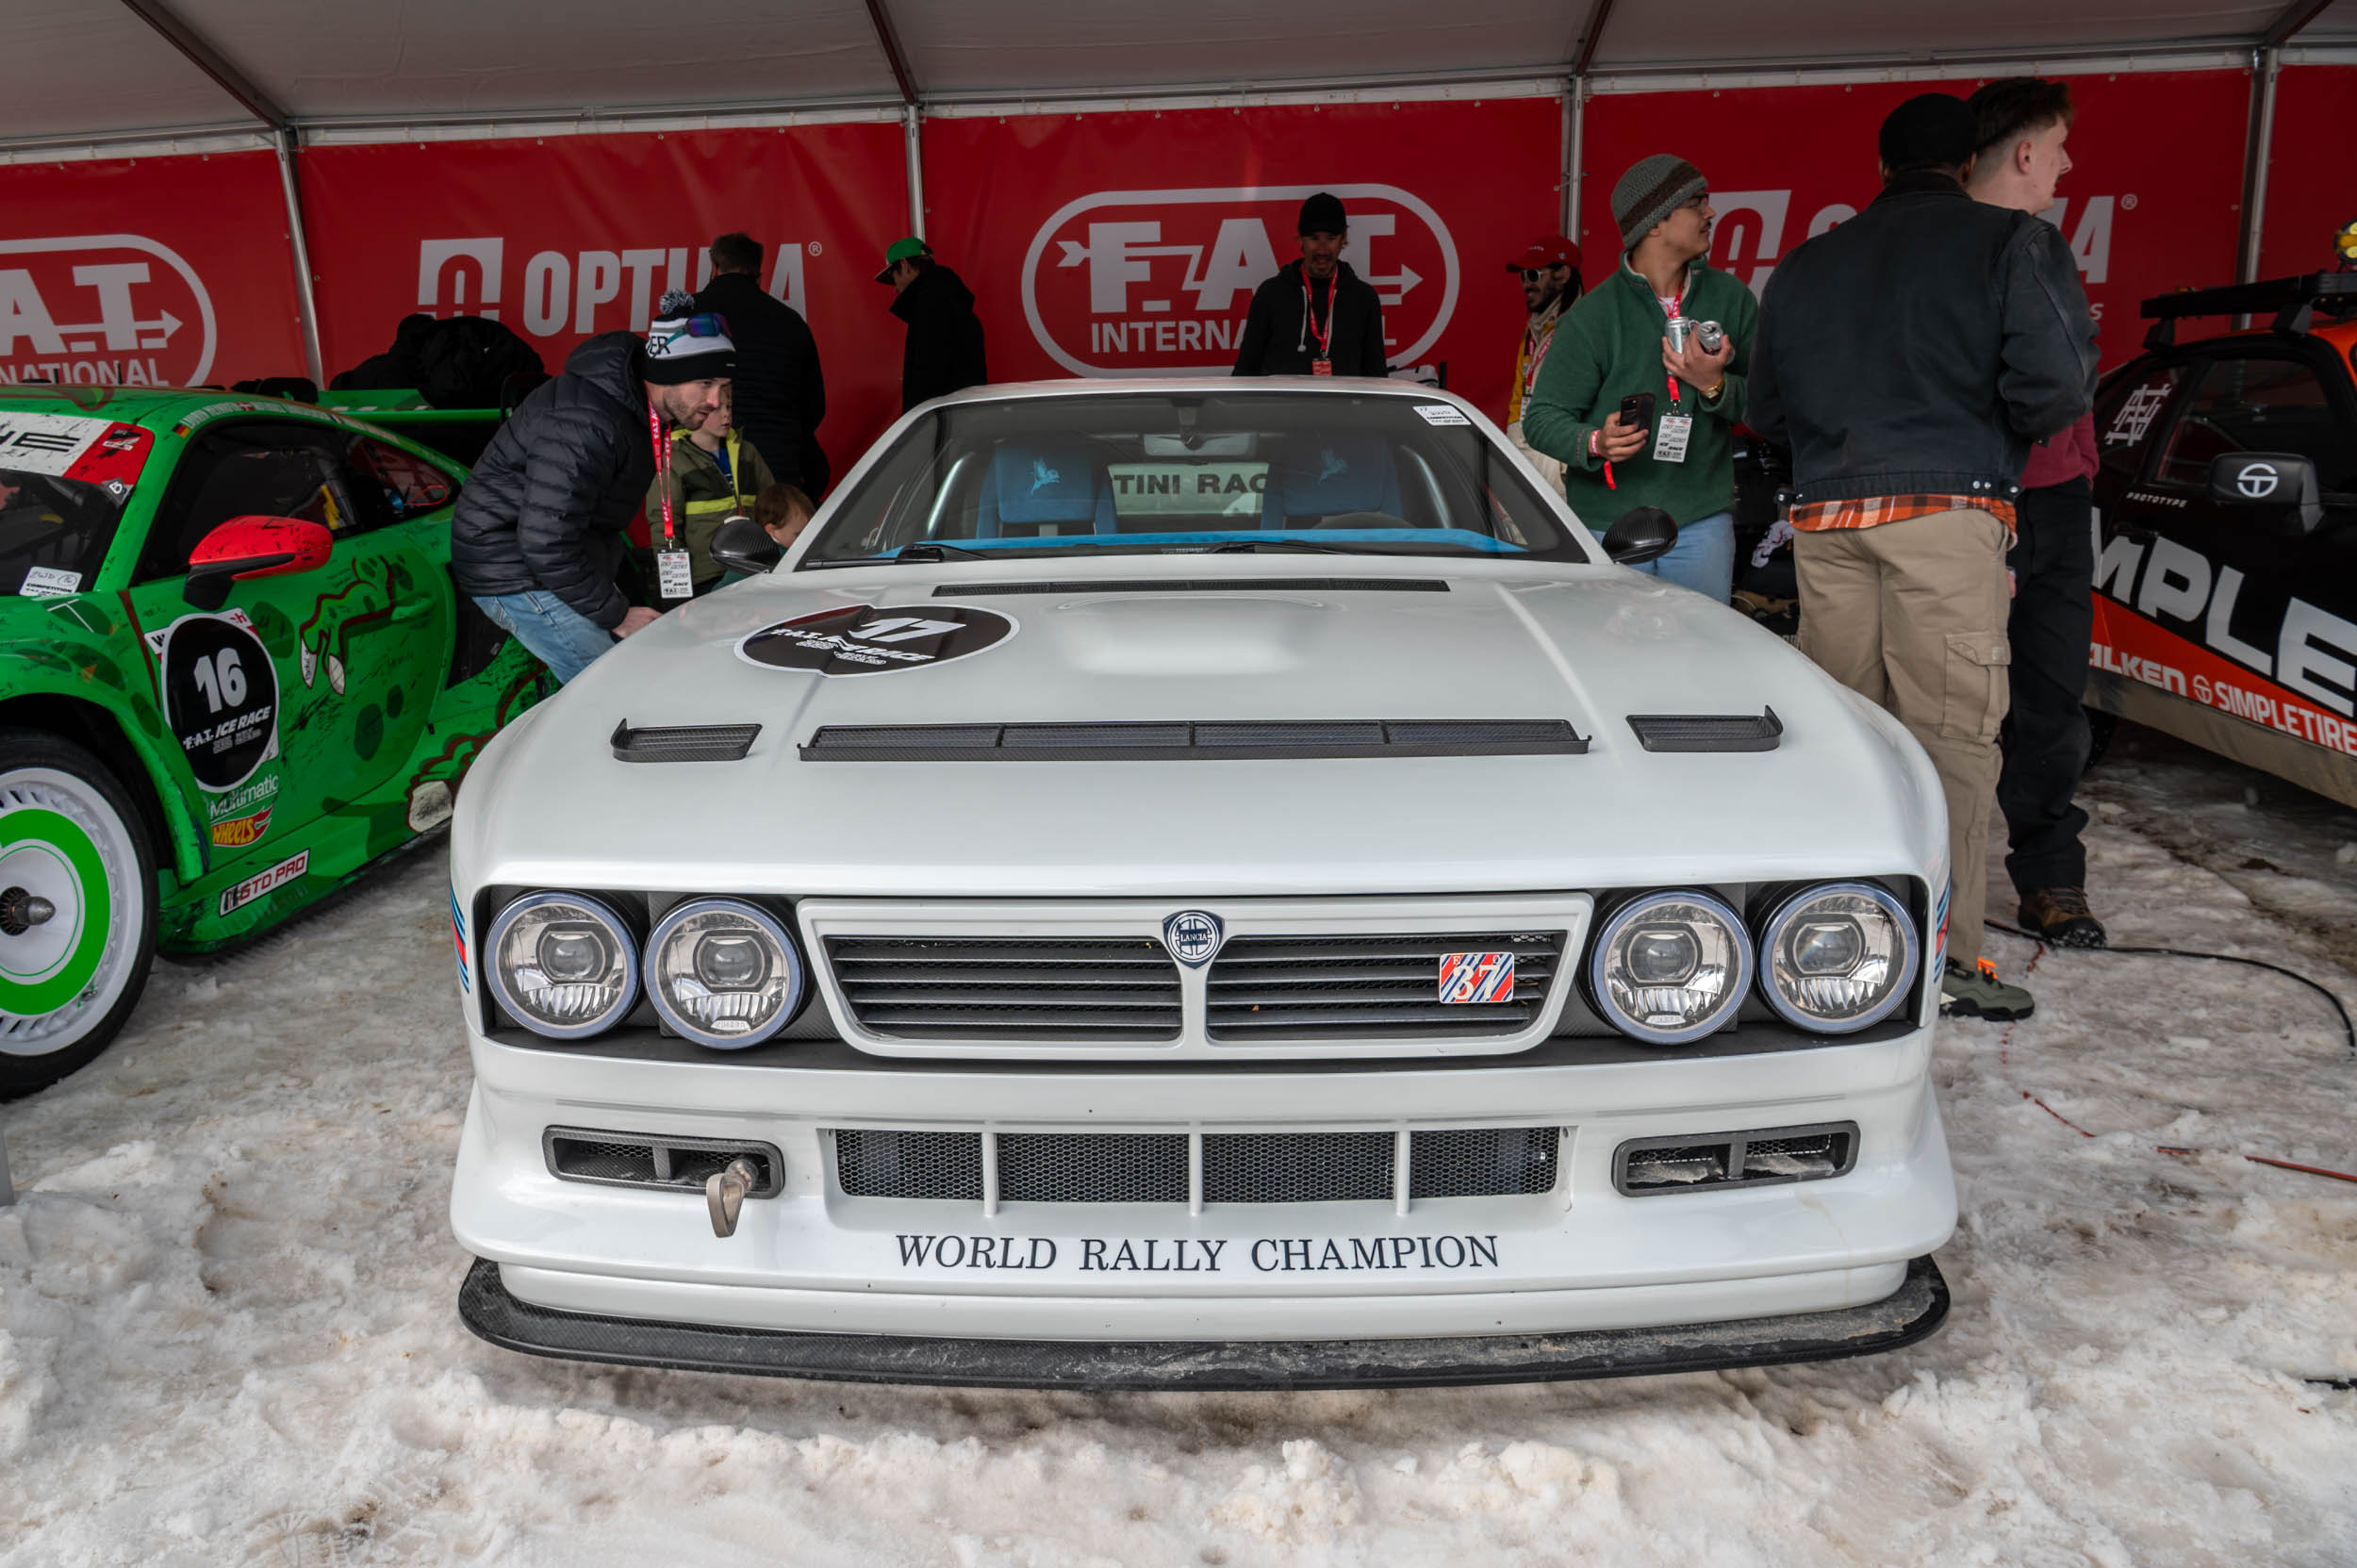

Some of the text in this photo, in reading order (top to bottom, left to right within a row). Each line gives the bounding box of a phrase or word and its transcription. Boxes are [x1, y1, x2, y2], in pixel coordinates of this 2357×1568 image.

[523, 243, 808, 338] OPTIA
[2126, 491, 2188, 508] PROTOTYPE
[193, 647, 248, 714] 16
[215, 718, 239, 739] ICE
[238, 705, 272, 729] RACE
[274, 855, 306, 883] PRO
[1179, 933, 1208, 942] LANCIA
[1452, 964, 1501, 999] 37
[896, 1234, 1499, 1272] WORLD RALLY CHAMPION
